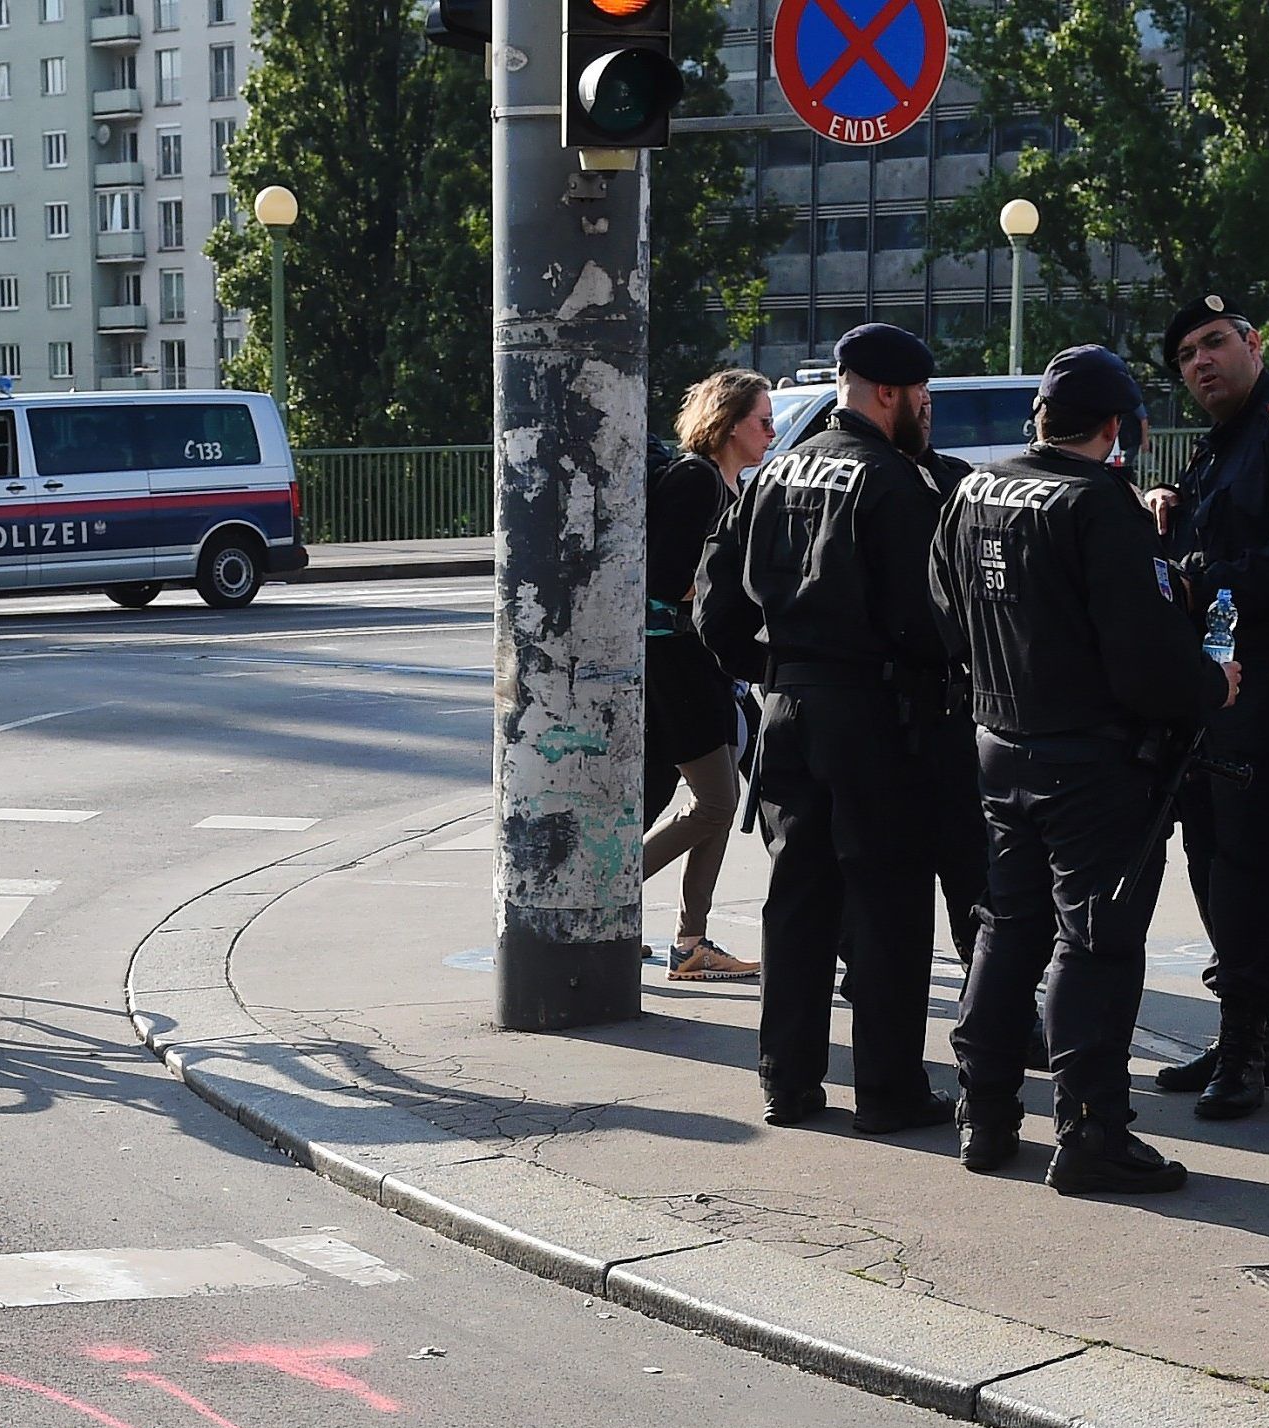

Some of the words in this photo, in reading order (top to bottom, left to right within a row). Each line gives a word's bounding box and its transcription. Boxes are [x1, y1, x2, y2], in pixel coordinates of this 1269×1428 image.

[828, 115, 892, 142] ENDE
[195, 442, 223, 460] 133
[759, 453, 867, 493] POLIZEI
[956, 471, 1070, 512] POLIZEI
[982, 539, 1003, 560] BE
[985, 569, 1006, 591] 50
